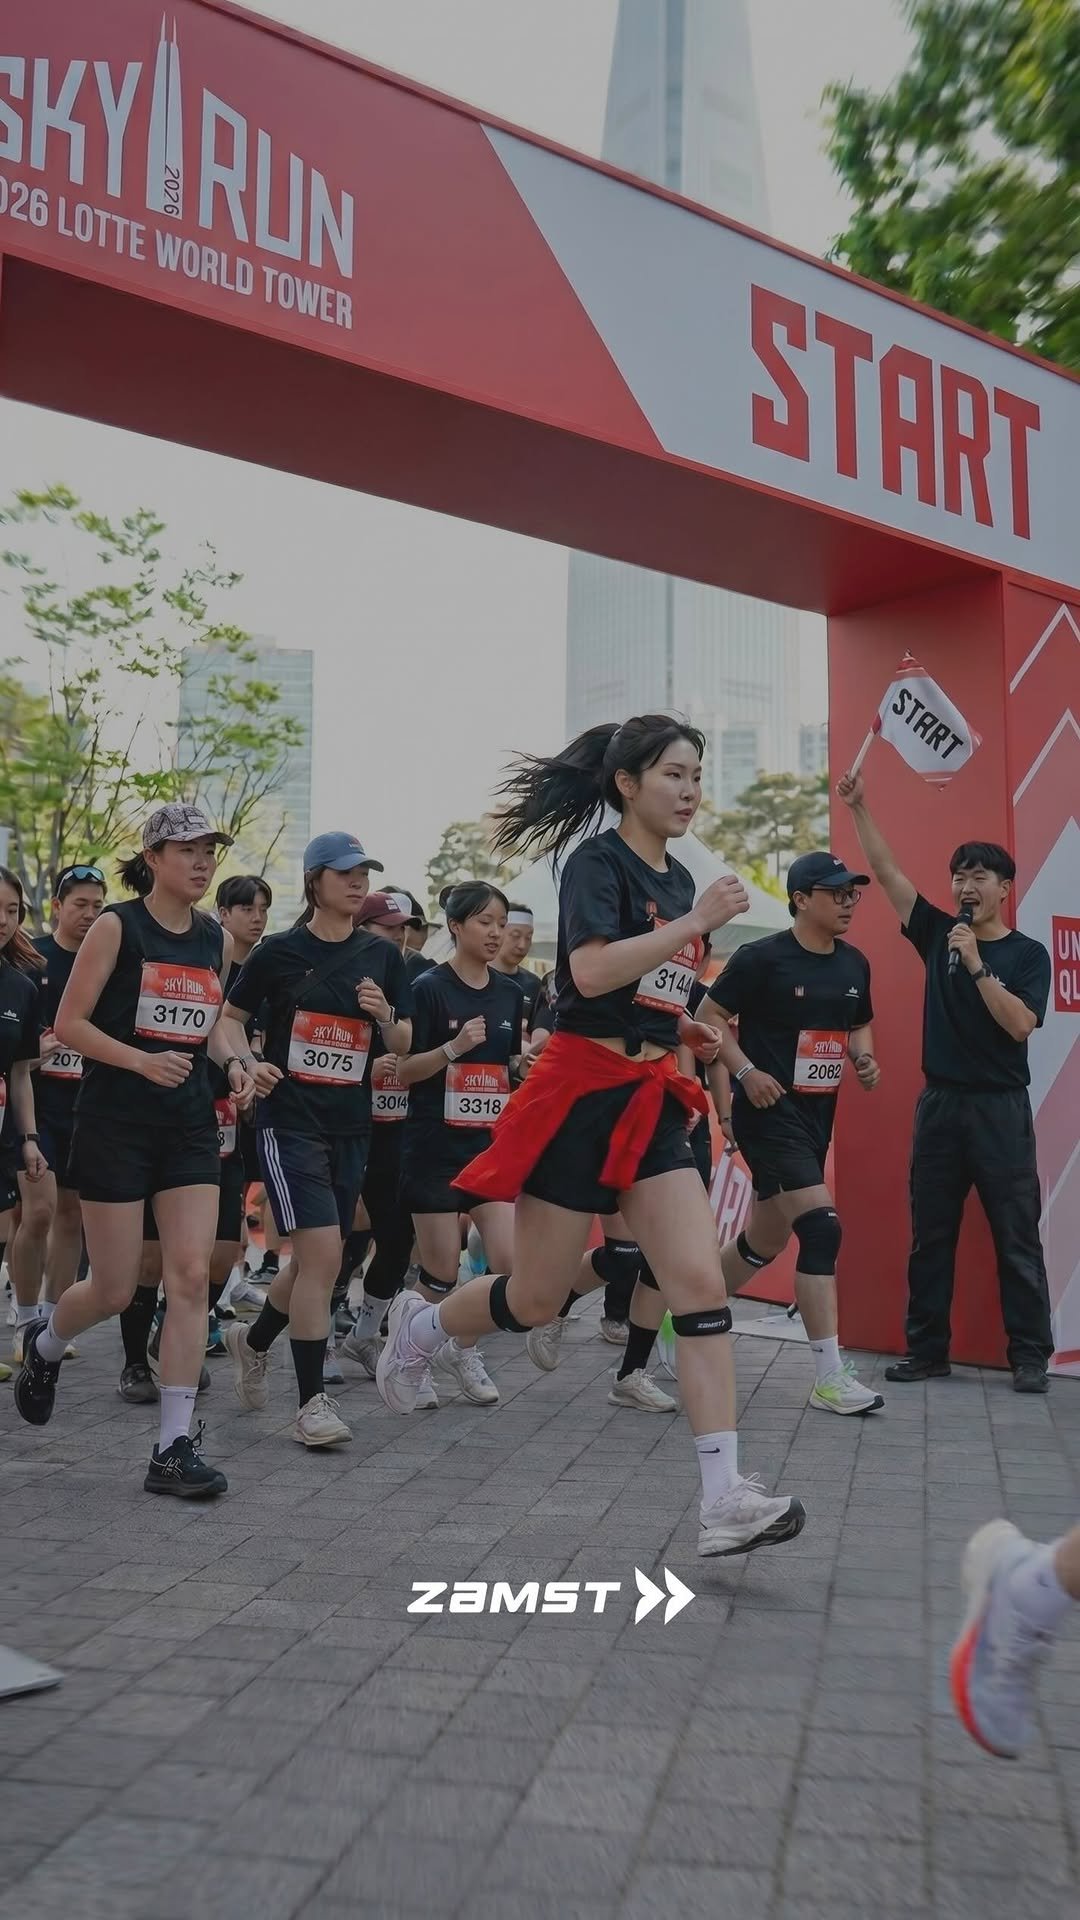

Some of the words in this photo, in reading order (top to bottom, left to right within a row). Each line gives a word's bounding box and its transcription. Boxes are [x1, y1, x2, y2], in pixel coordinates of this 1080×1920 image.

[163, 165, 181, 217] 2026
[198, 87, 354, 279] RUN
[57, 195, 147, 261] LOTTE
[155, 229, 254, 296] WORLD
[261, 265, 353, 330] TOWER
[750, 282, 1041, 541] START
[892, 687, 964, 760] START
[654, 968, 692, 998] 3144
[152, 1004, 207, 1029] 3170
[302, 1049, 354, 1073] 3075
[807, 1063, 842, 1080] 2062
[459, 1097, 502, 1115] 3318
